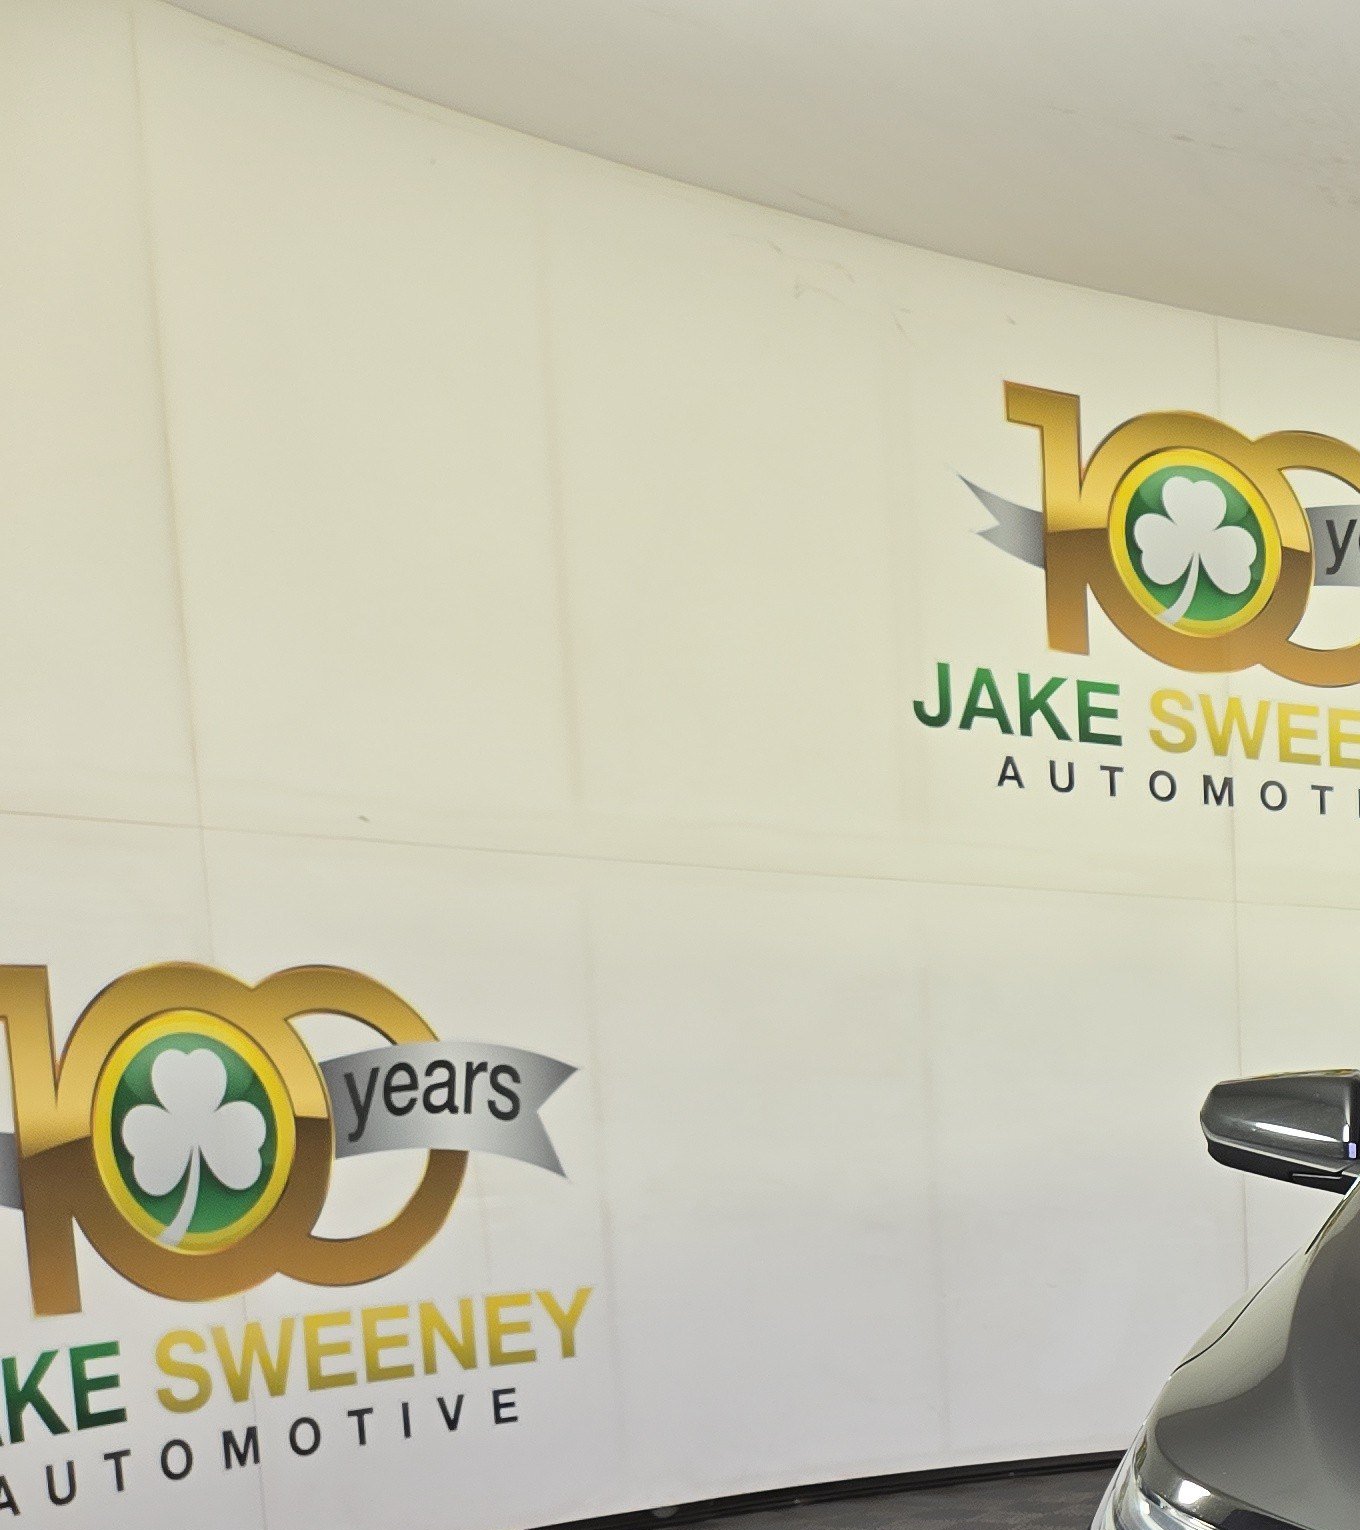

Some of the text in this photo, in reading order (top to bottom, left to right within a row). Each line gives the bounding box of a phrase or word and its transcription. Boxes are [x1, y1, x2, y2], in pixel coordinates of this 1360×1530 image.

[912, 661, 1123, 747] JAKE
[342, 1059, 523, 1143] years
[0, 1287, 594, 1446] KE SWEENEY
